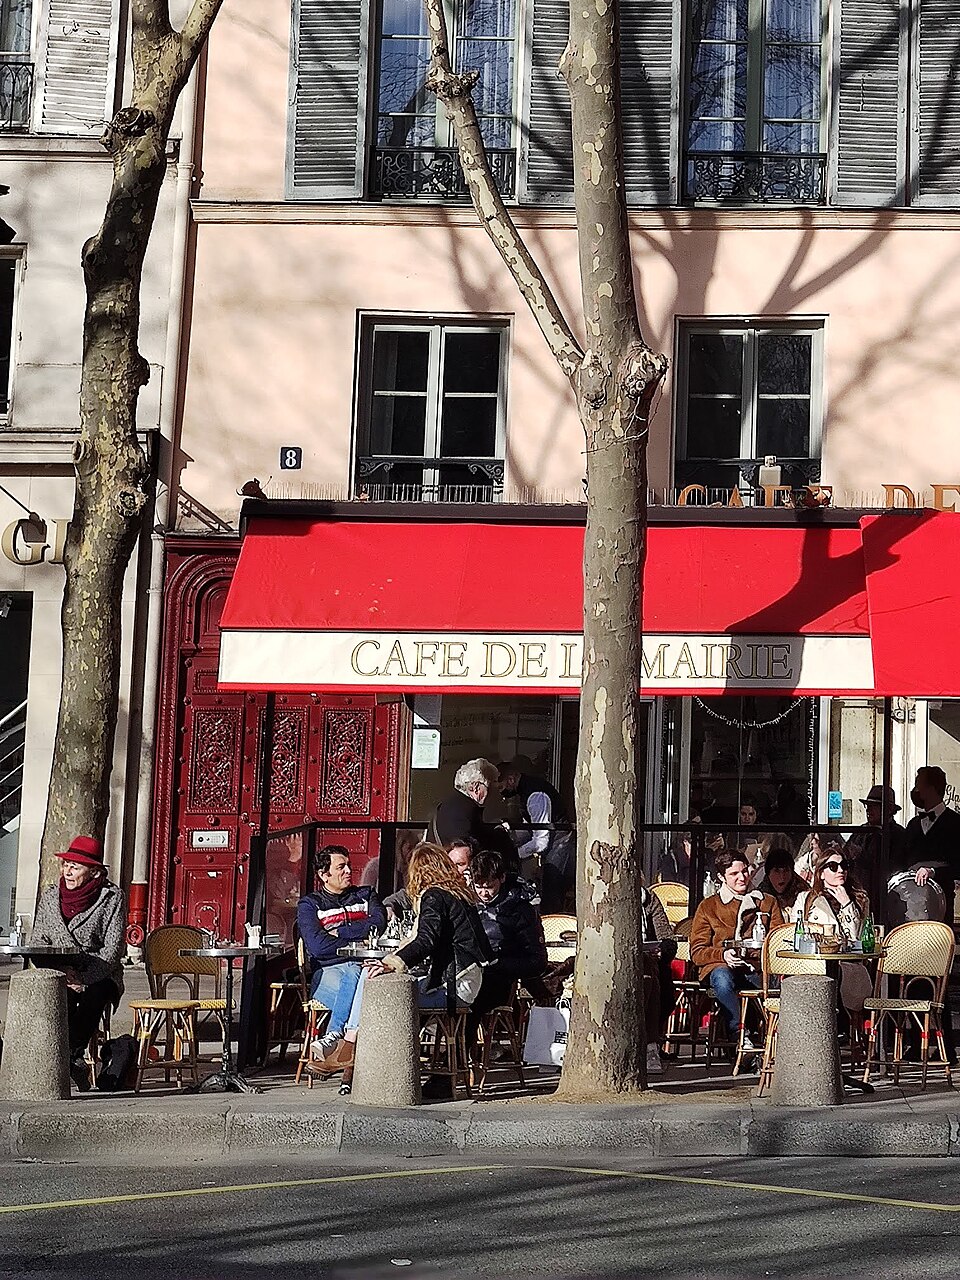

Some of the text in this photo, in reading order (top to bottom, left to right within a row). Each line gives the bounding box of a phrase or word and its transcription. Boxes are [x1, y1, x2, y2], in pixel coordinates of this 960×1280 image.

[284, 449, 298, 468] 8
[350, 639, 470, 677] CAFE
[480, 641, 548, 678] DE
[640, 641, 793, 680] MAIRIE
